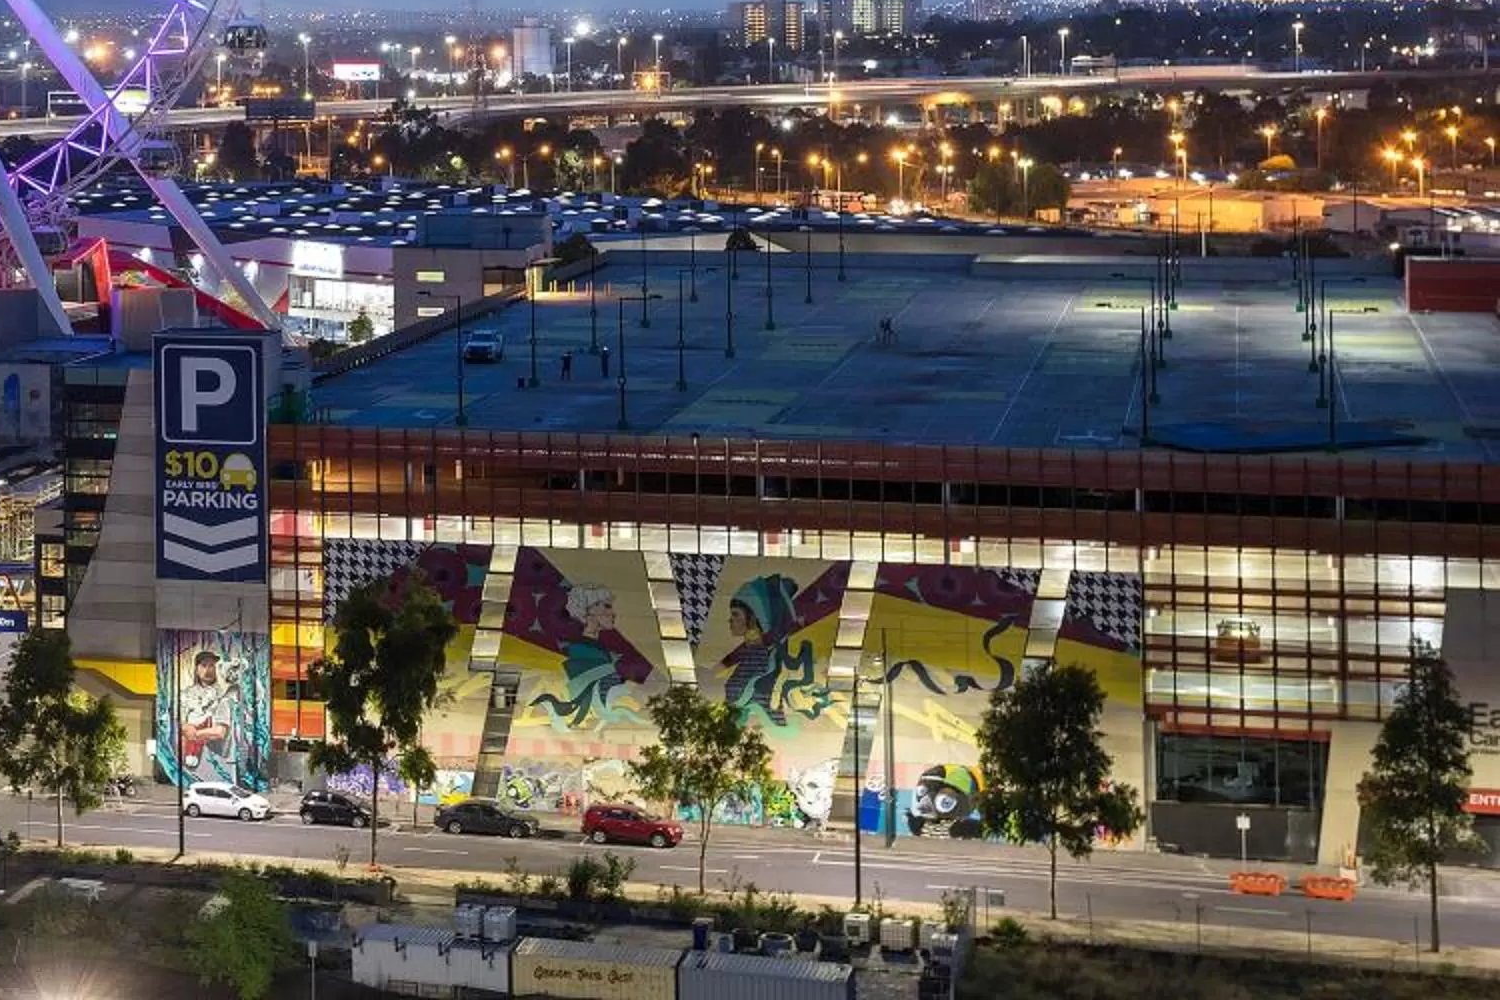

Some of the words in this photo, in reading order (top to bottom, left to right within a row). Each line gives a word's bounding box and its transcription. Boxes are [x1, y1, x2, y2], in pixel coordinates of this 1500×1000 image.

[181, 357, 237, 431] P
[165, 450, 218, 479] $10
[166, 480, 194, 489] EARLY
[163, 490, 259, 510] PARKING
